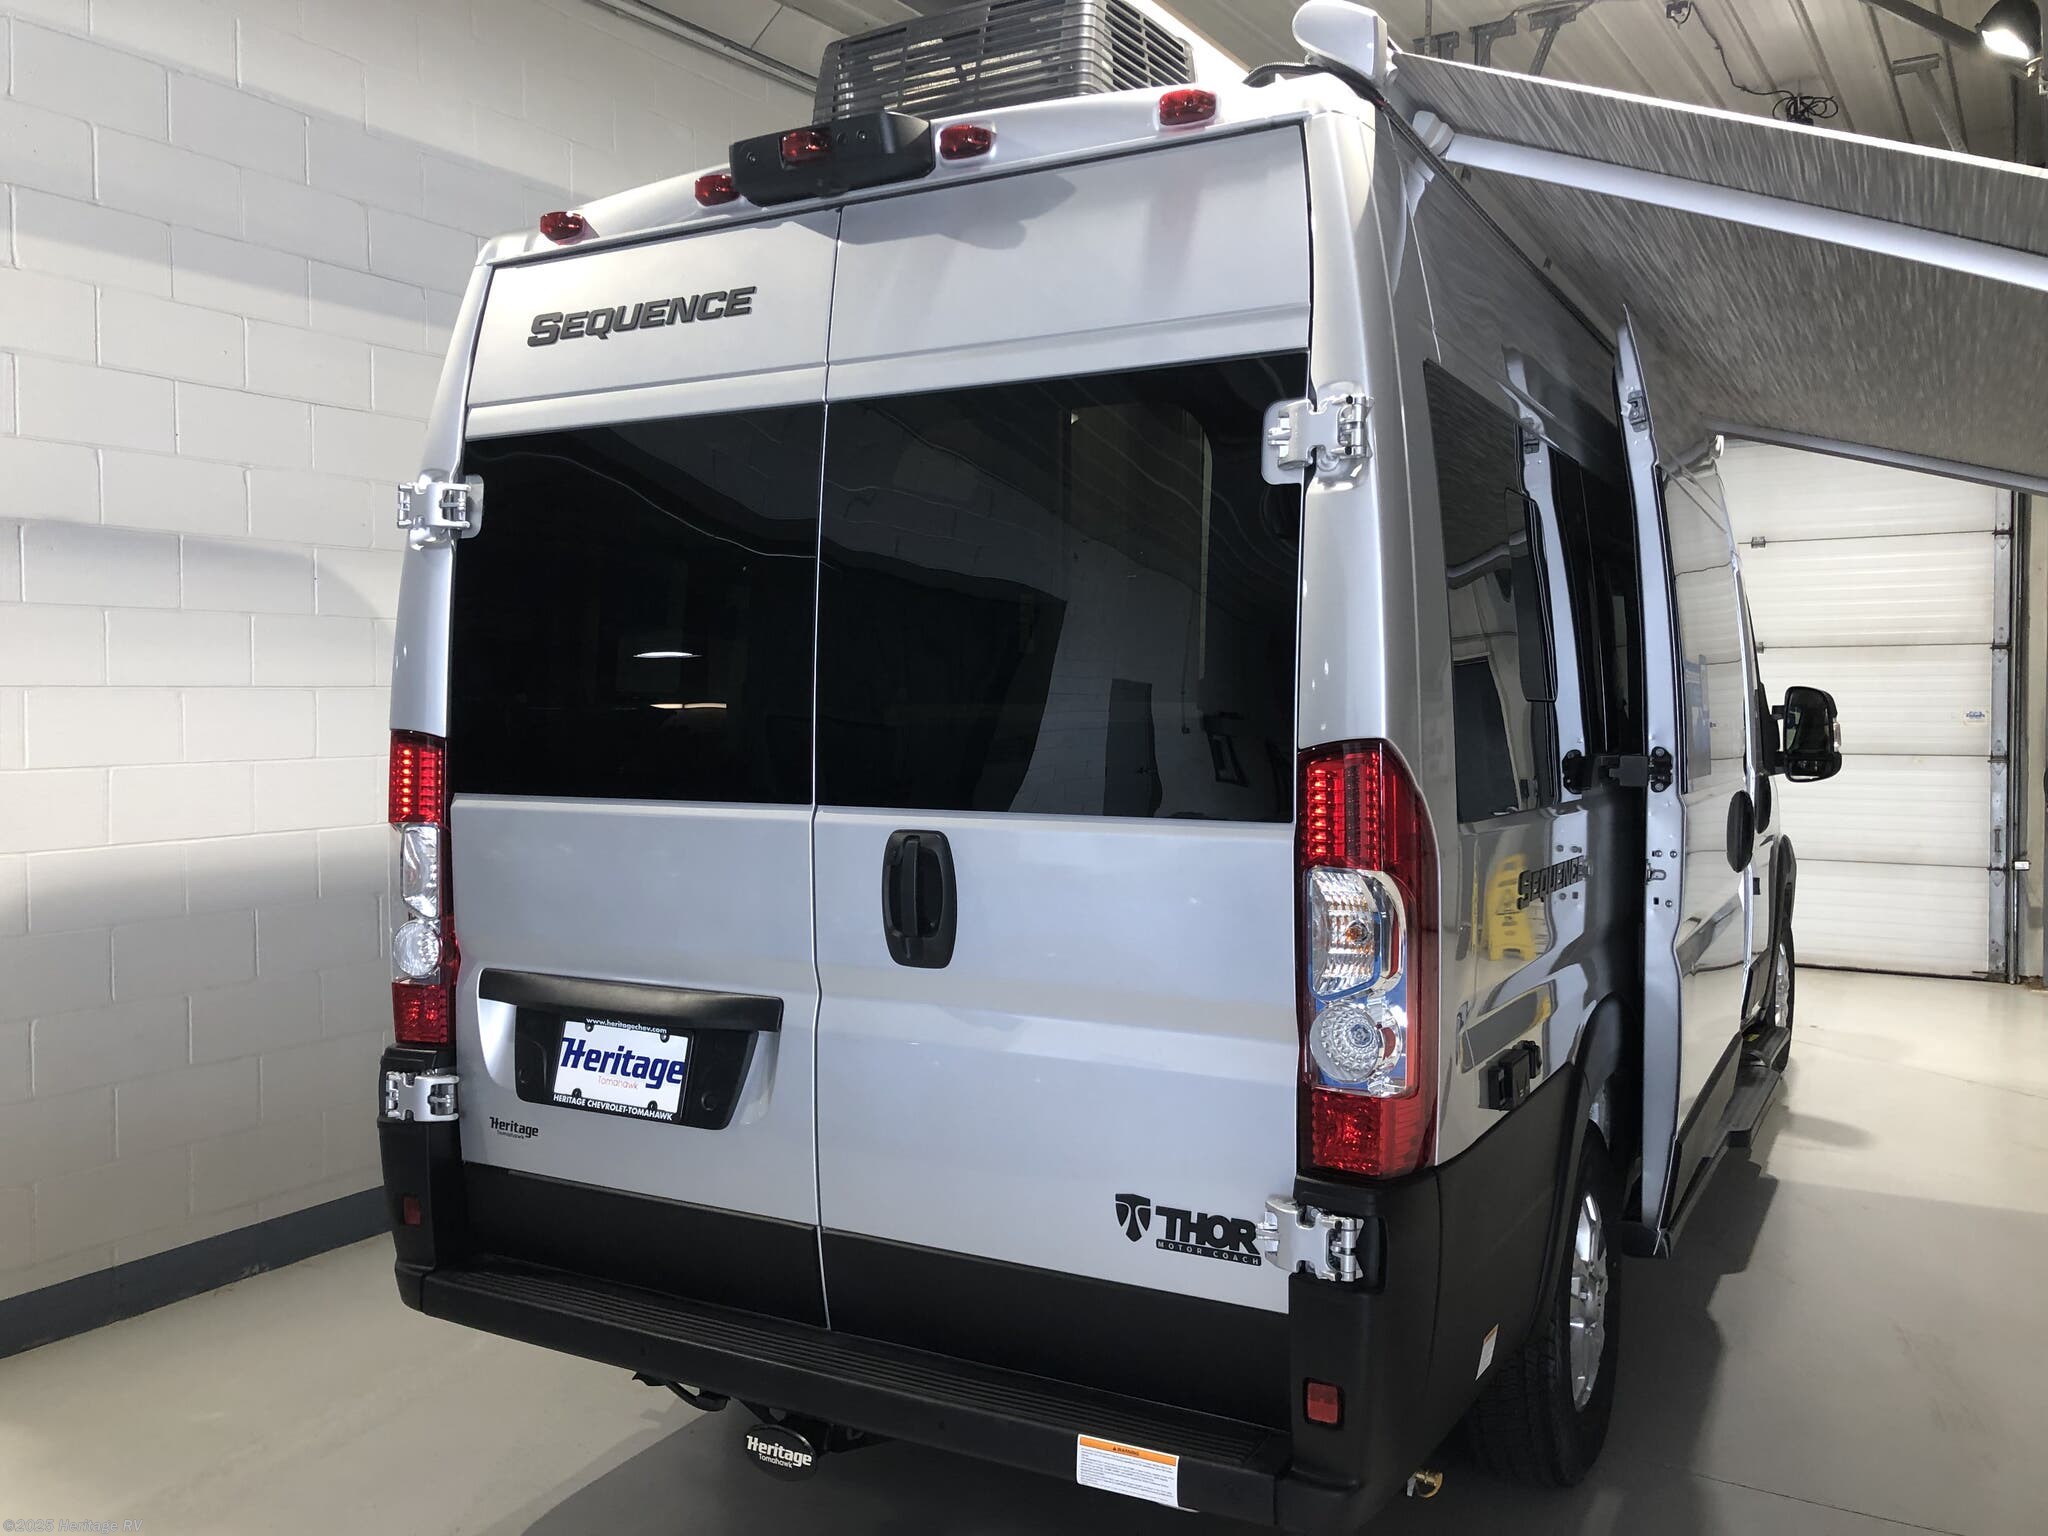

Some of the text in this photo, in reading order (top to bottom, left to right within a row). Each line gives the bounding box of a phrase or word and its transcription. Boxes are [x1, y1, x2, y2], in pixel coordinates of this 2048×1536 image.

[527, 286, 757, 347] SEQUENCE
[586, 1018, 667, 1034] www.heritagechev.com
[560, 1037, 685, 1089] Heritage
[598, 1075, 638, 1090] Tomahawk
[553, 1094, 673, 1121] HERITAGE CHEVROLET-TOMAHAWK
[489, 1116, 539, 1138] Heritage
[1155, 1205, 1261, 1255] THOR
[1157, 1241, 1260, 1265] MOTOR COACH
[746, 1434, 812, 1468] Heritage
[758, 1453, 793, 1469] Tomahawk
